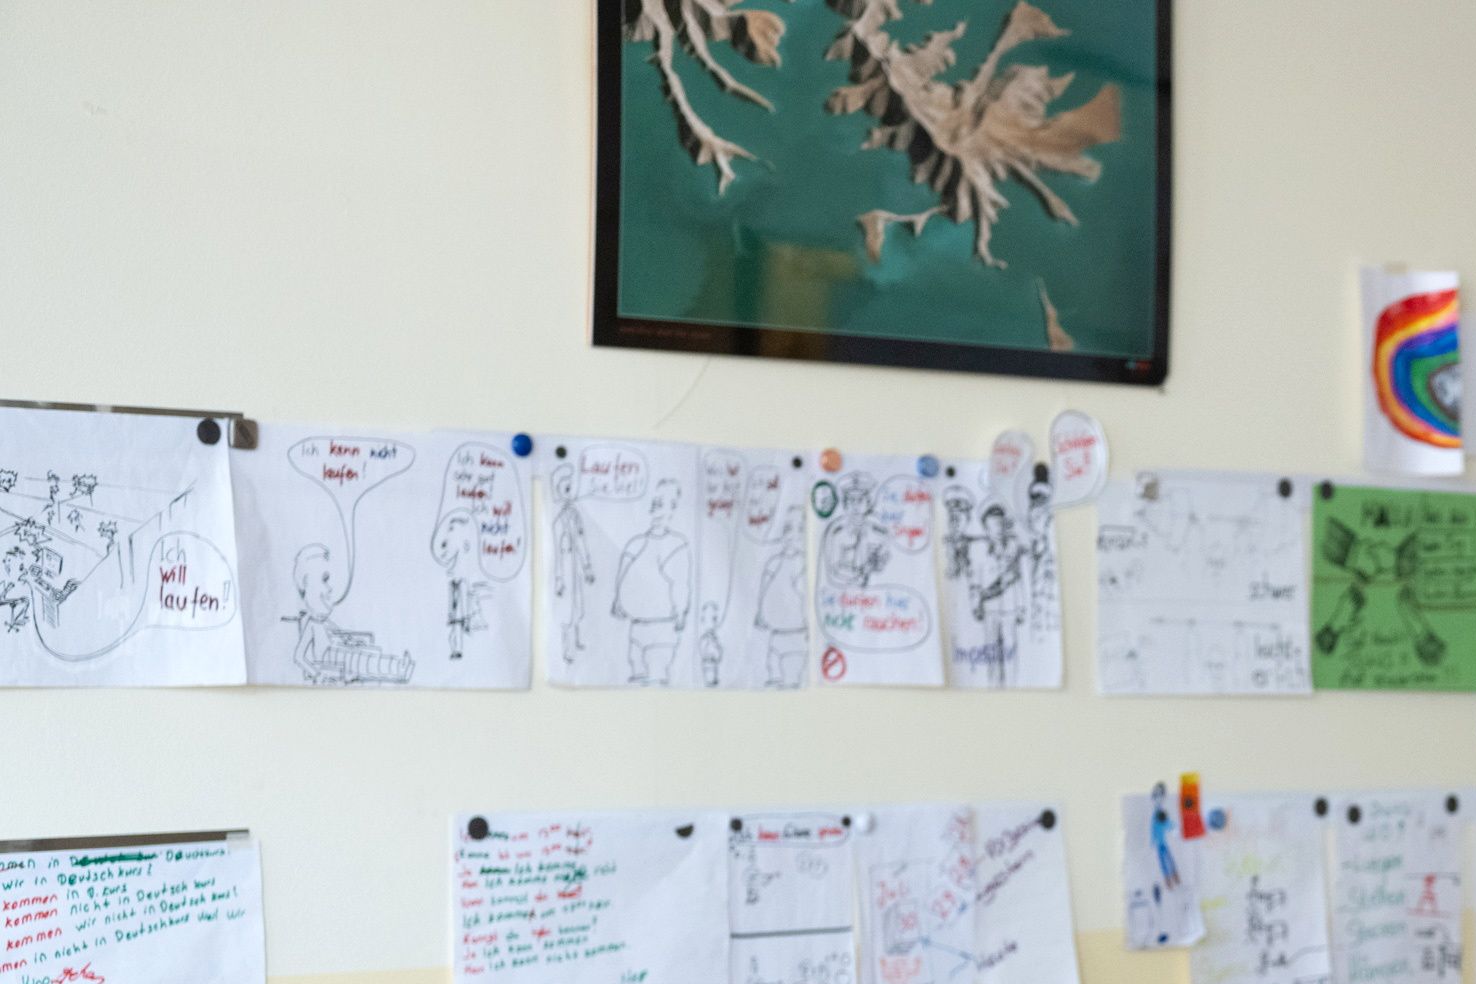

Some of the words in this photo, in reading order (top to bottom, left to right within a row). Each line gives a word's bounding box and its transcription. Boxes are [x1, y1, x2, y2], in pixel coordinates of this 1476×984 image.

[329, 440, 360, 456] kann
[160, 537, 187, 564] Ich
[160, 565, 187, 585] will
[160, 580, 232, 619] laufen!
[3, 892, 58, 912] kommen
[5, 906, 58, 928] kommen
[70, 899, 111, 916] nicht
[6, 928, 63, 951] kommen
[76, 917, 97, 932] wir
[105, 907, 137, 924] nicht
[55, 940, 89, 960] nicht
